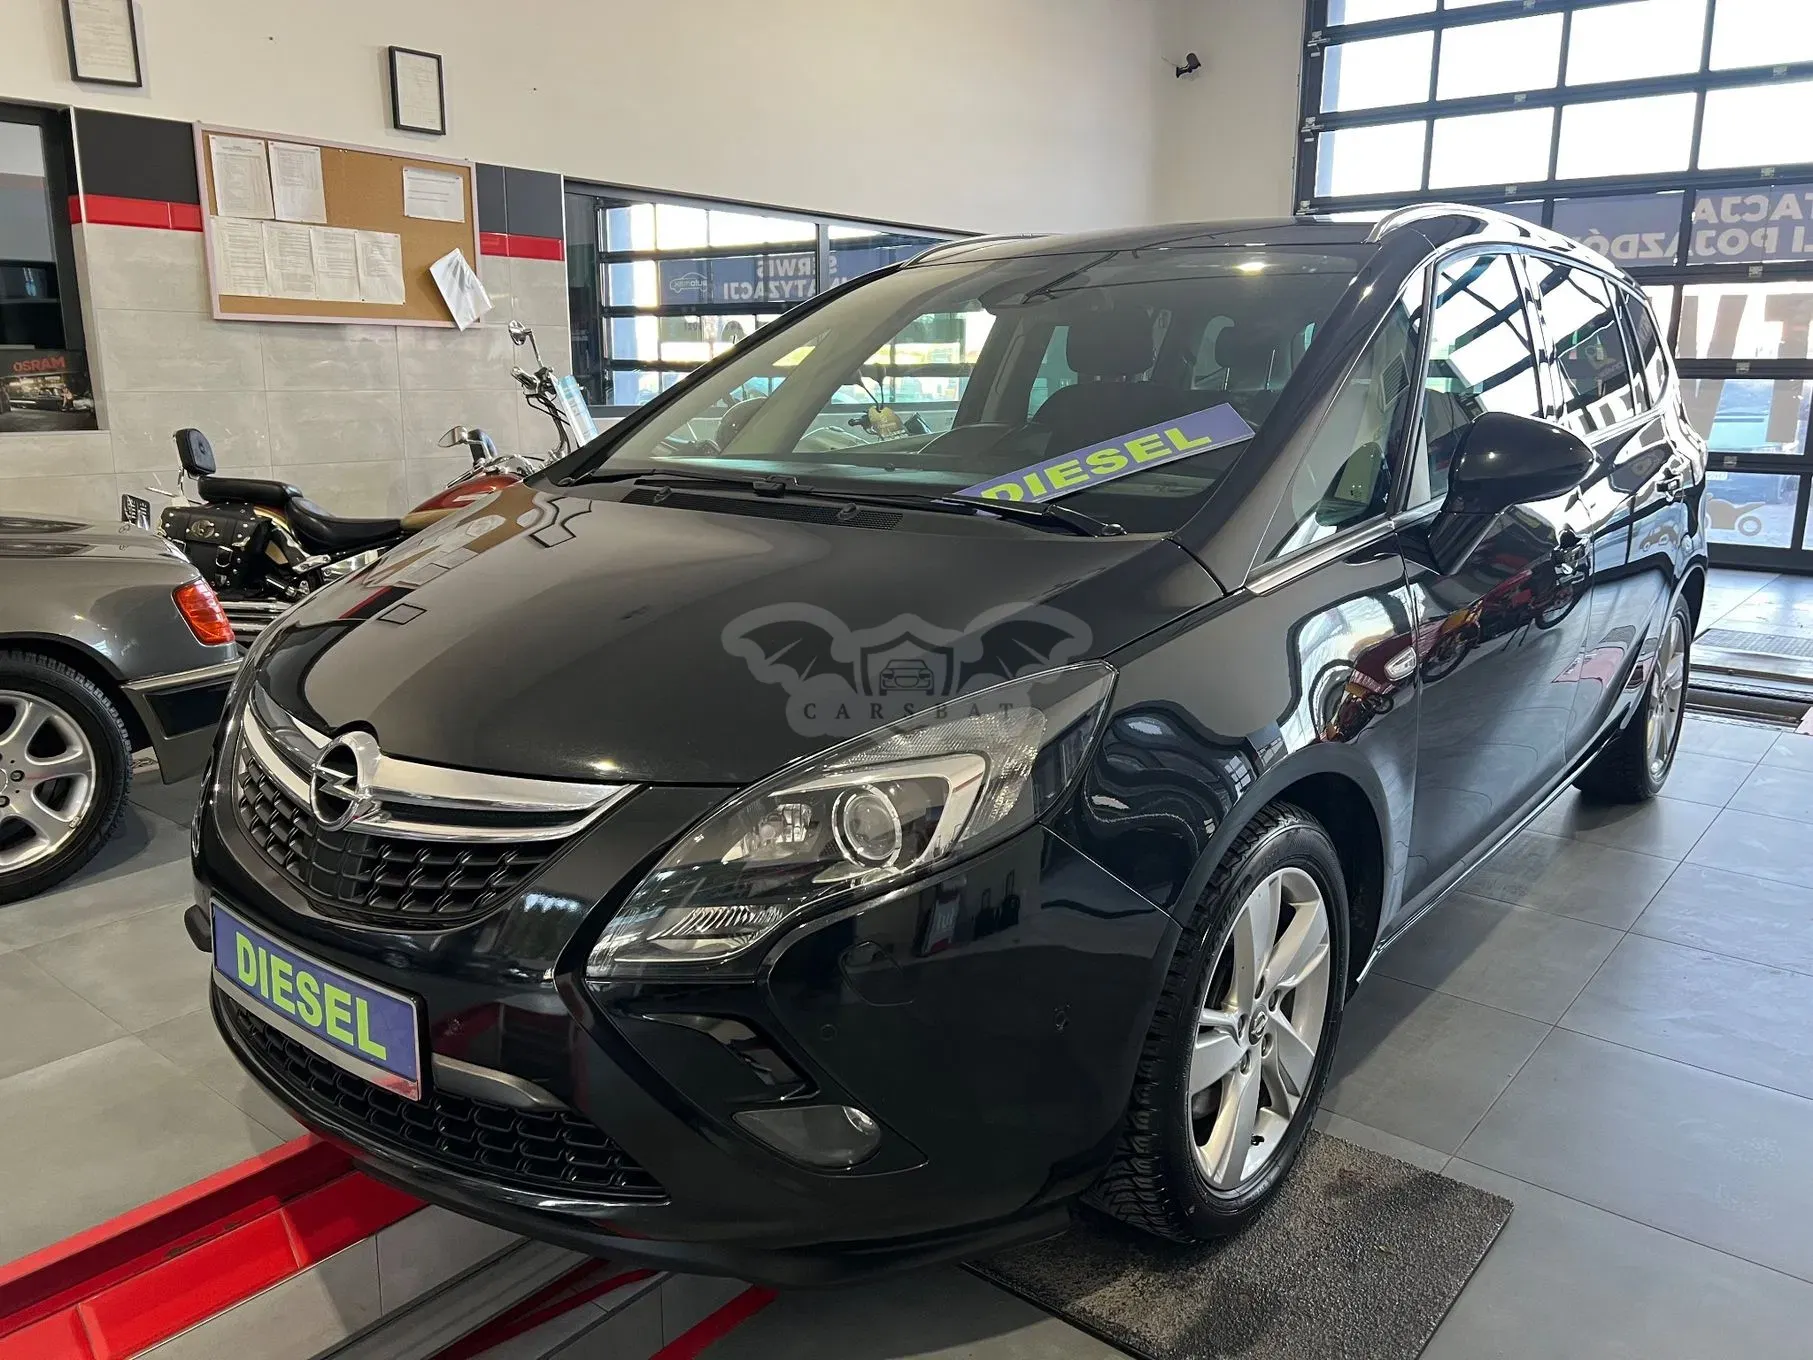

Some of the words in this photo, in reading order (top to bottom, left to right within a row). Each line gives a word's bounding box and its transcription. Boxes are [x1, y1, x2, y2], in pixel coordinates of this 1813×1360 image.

[13, 356, 66, 372] OSRAM
[982, 427, 1212, 502] DIESEL
[235, 931, 387, 1061] DIESEL
